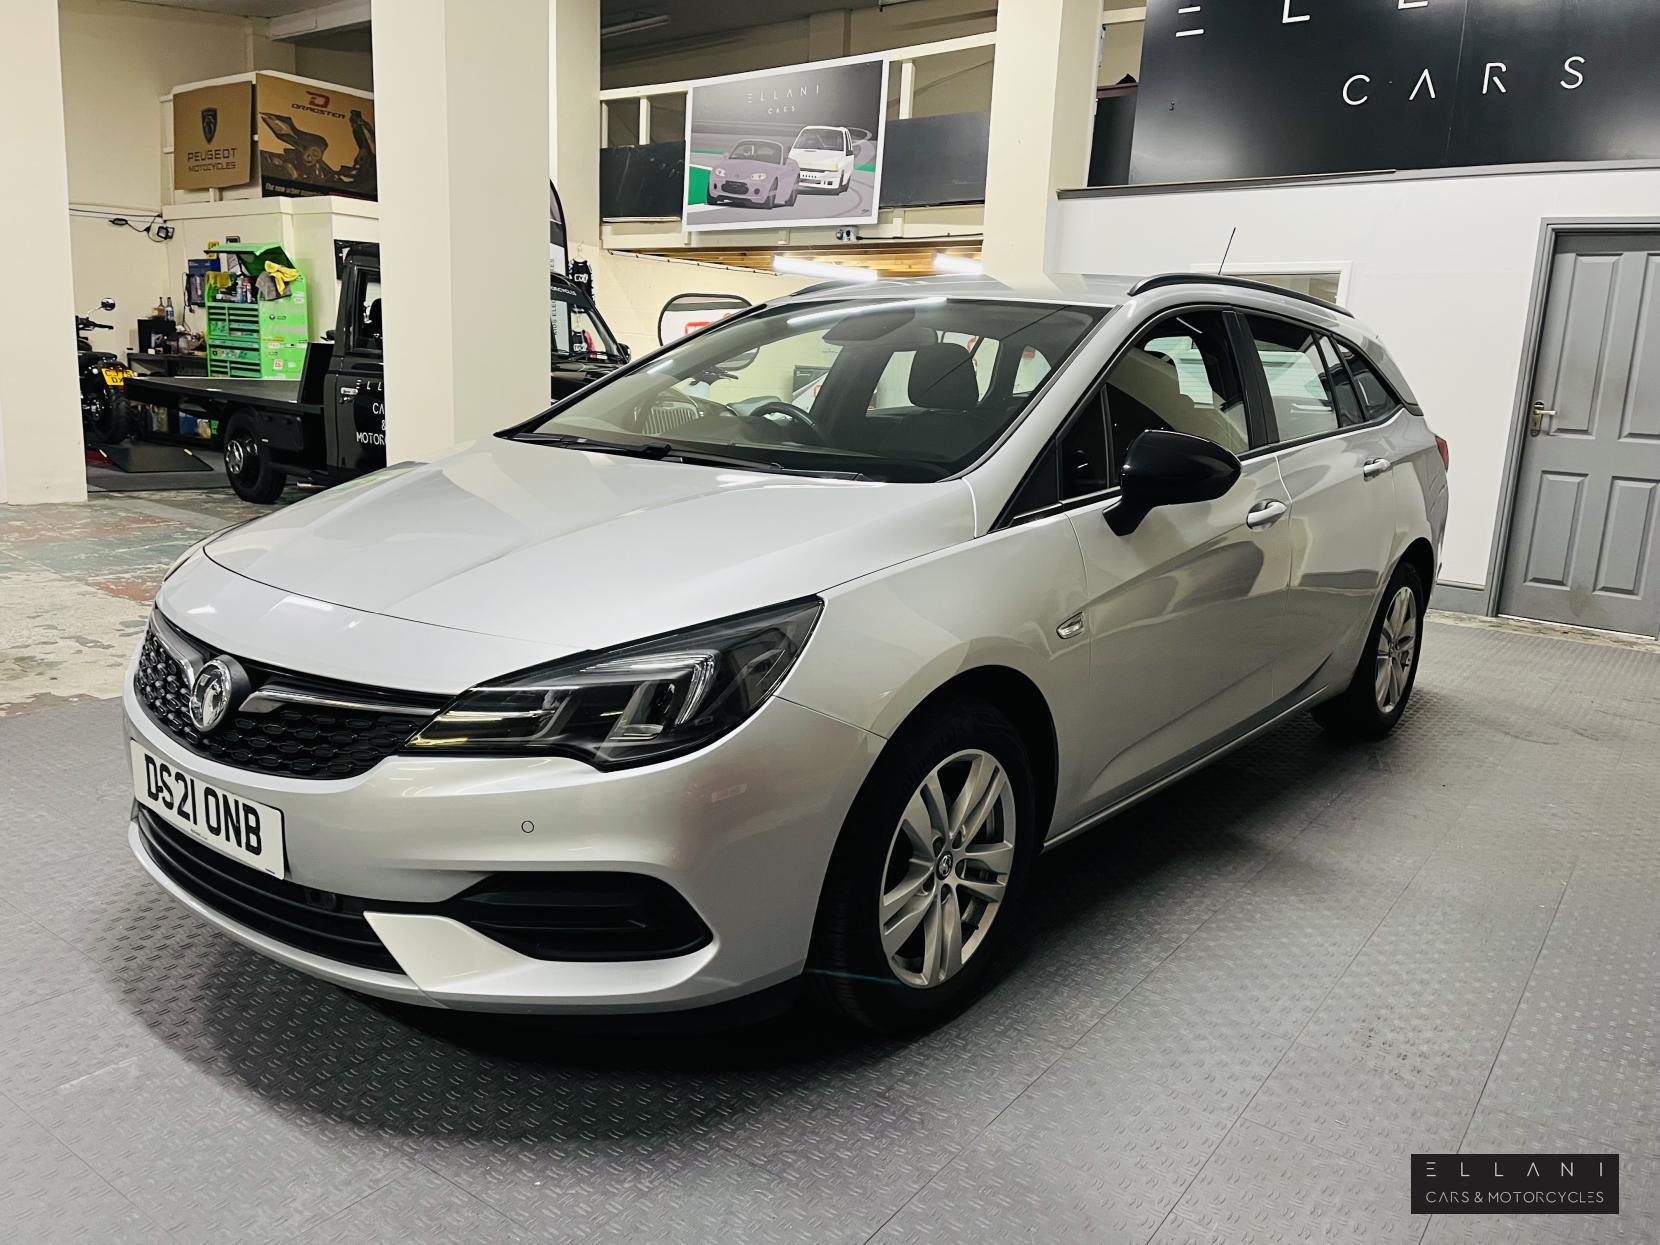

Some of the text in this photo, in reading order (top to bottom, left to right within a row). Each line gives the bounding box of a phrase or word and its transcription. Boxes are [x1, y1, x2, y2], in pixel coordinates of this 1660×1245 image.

[1342, 55, 1586, 106] CARS
[746, 83, 820, 104] ELLANI
[291, 103, 346, 120] DRAGSTER
[767, 105, 796, 115] CARS
[187, 147, 237, 162] PEUGEOT
[144, 753, 262, 856] DS21 ONB
